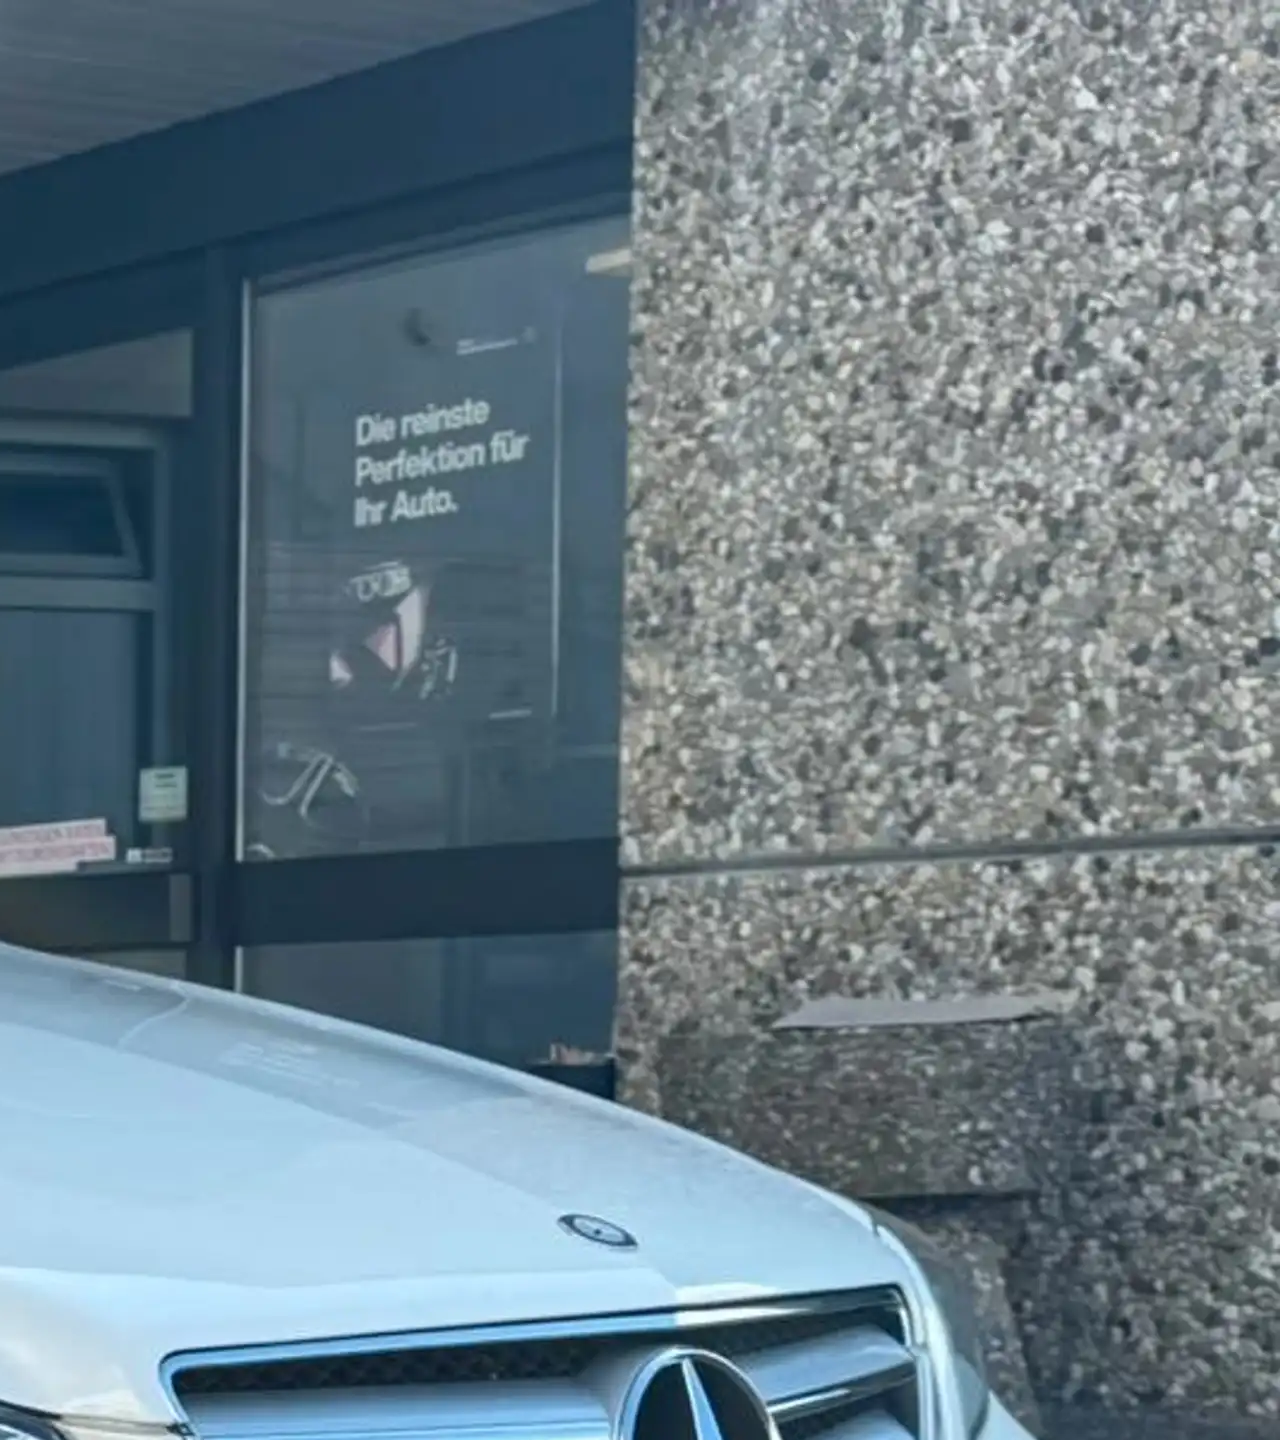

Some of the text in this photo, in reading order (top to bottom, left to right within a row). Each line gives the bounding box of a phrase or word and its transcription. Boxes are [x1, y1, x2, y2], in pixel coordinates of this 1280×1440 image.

[356, 398, 490, 447] Die reinste
[355, 428, 531, 488] Perfektion für
[354, 486, 460, 527] Ihr Auto.
